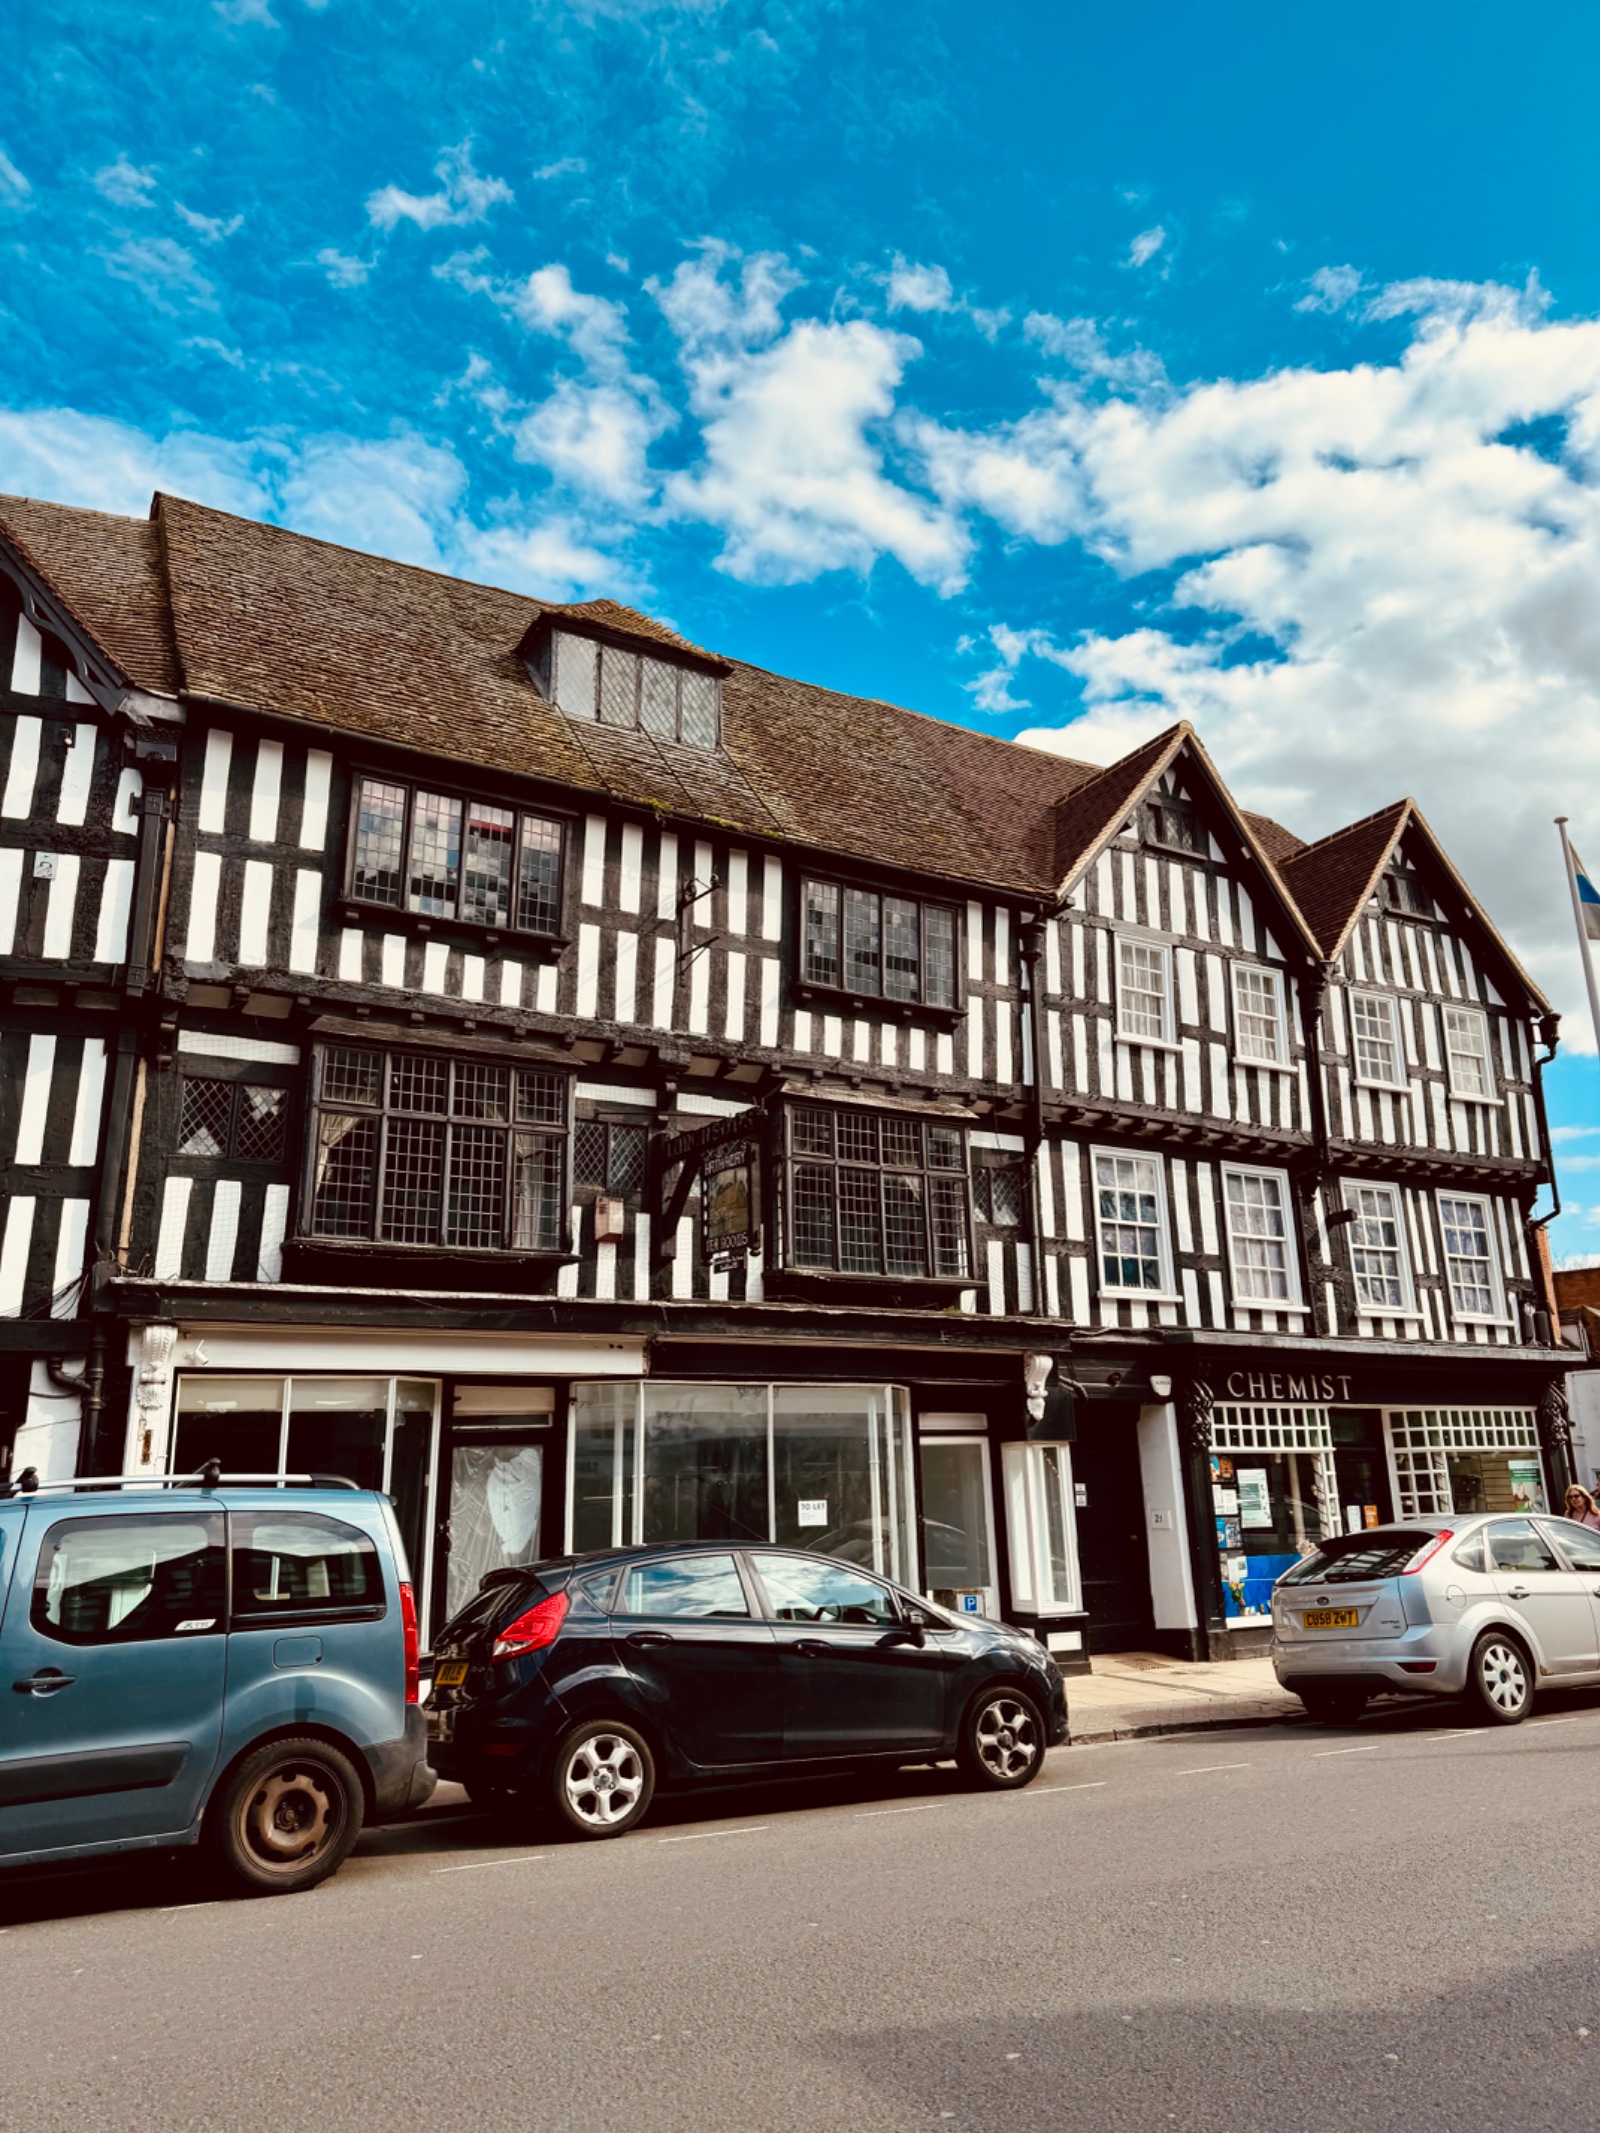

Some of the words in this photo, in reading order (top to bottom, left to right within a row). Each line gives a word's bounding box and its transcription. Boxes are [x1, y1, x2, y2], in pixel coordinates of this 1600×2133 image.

[1227, 1371, 1352, 1400] CHEMIST
[813, 1502, 825, 1510] LET
[1155, 1514, 1162, 1523] 21
